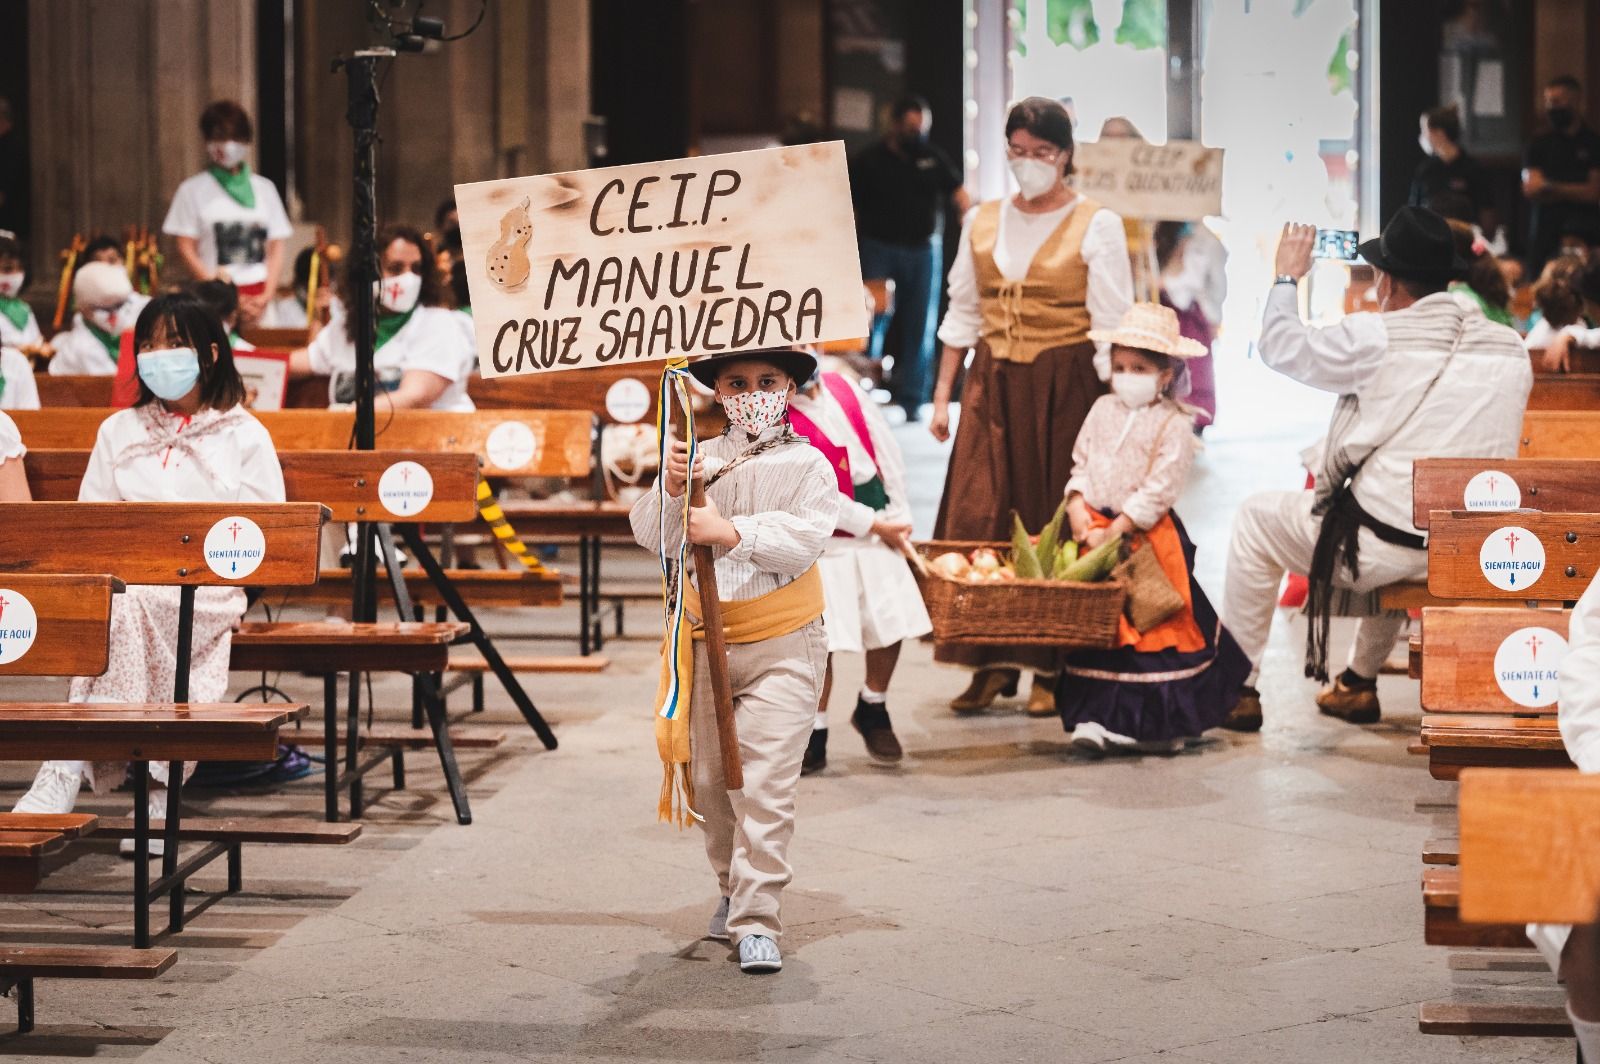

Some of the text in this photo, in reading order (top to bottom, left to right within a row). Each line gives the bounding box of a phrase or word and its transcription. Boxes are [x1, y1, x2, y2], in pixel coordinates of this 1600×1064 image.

[543, 243, 764, 310] MANUEL
[492, 287, 823, 373] CRUZ SAAVEDRA
[208, 549, 240, 559] SIENTATE
[1484, 561, 1520, 570] SIENTATE
[1501, 671, 1543, 681] SIENTATE
